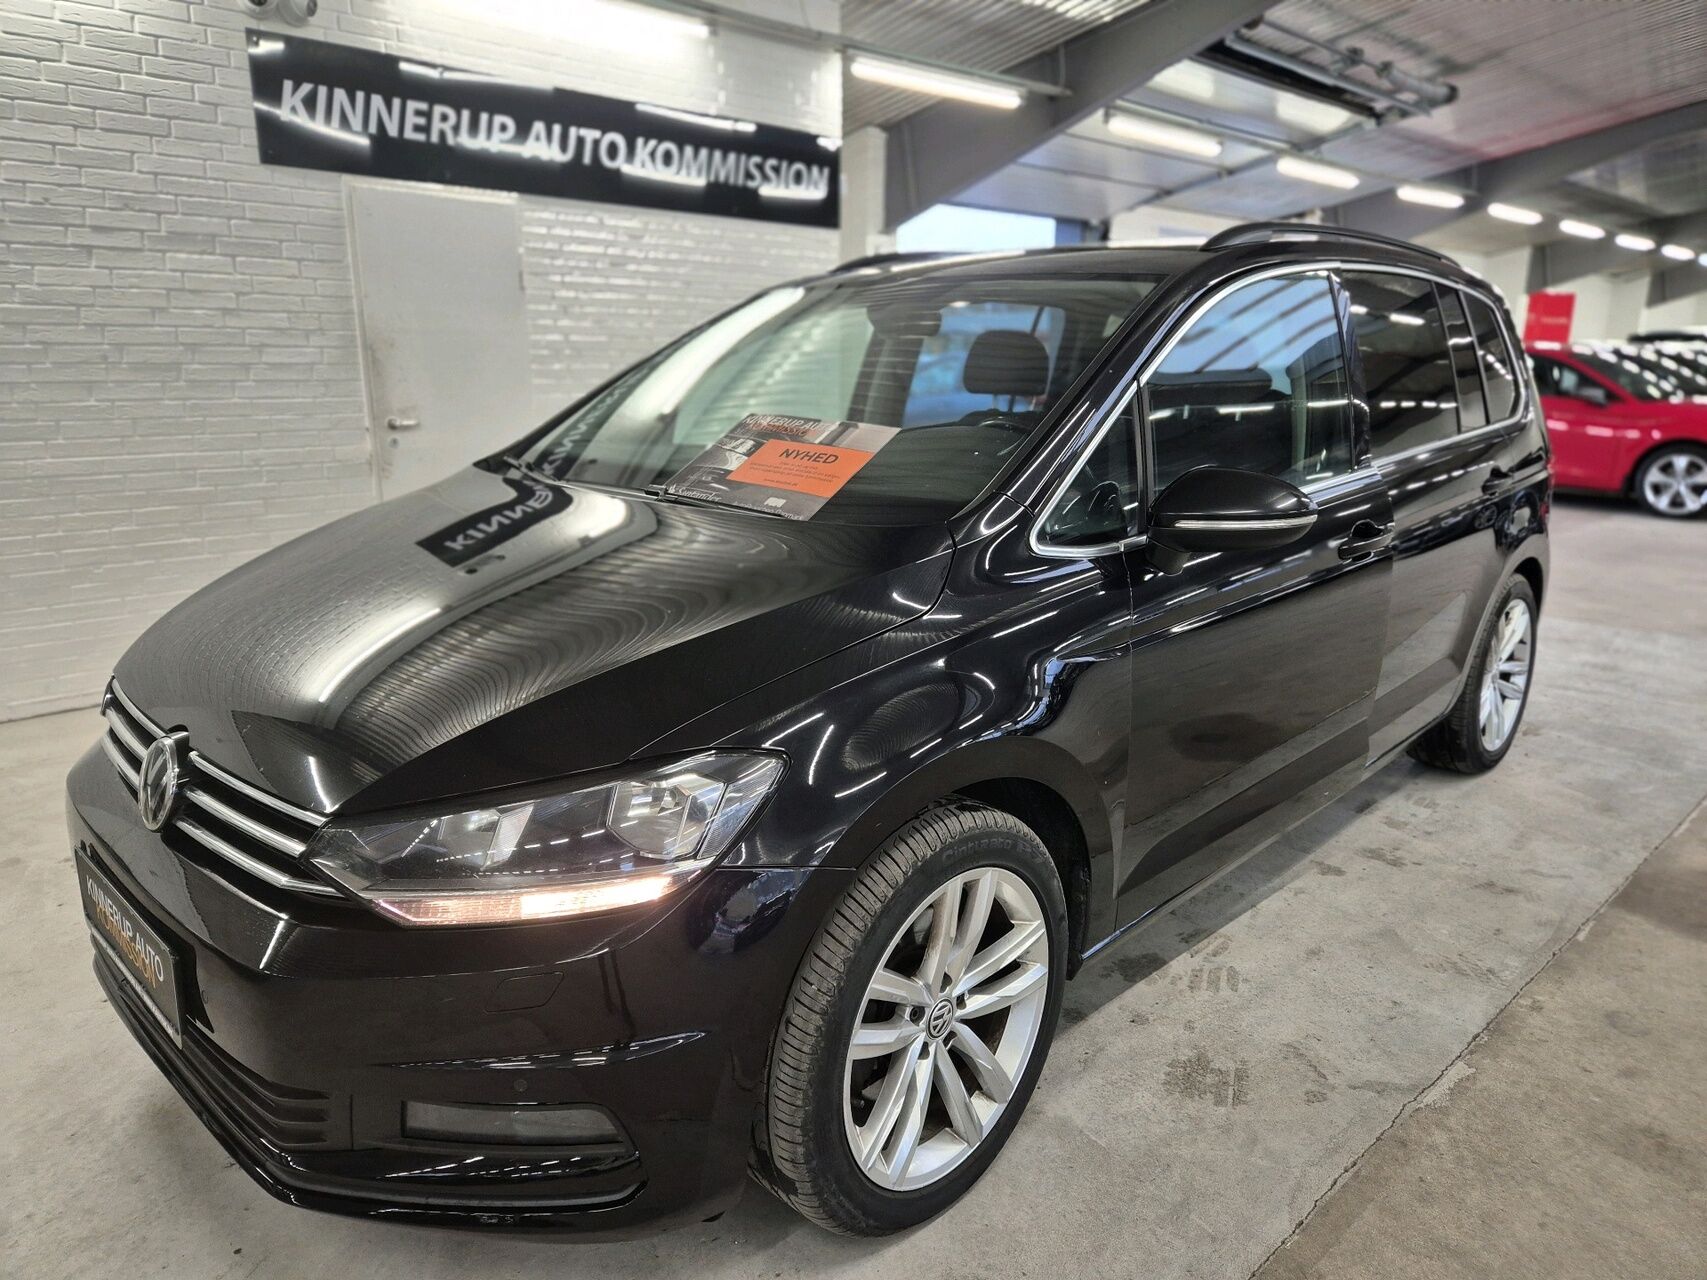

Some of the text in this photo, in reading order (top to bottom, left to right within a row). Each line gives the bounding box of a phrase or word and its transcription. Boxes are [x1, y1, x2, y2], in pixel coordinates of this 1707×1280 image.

[280, 79, 830, 193] KINNERUP AUTO KOMMISSION
[743, 415, 804, 429] KINNERUP
[779, 448, 839, 465] NYHED
[679, 487, 722, 502] Santander
[86, 875, 165, 982] KINNERUP AUTO
